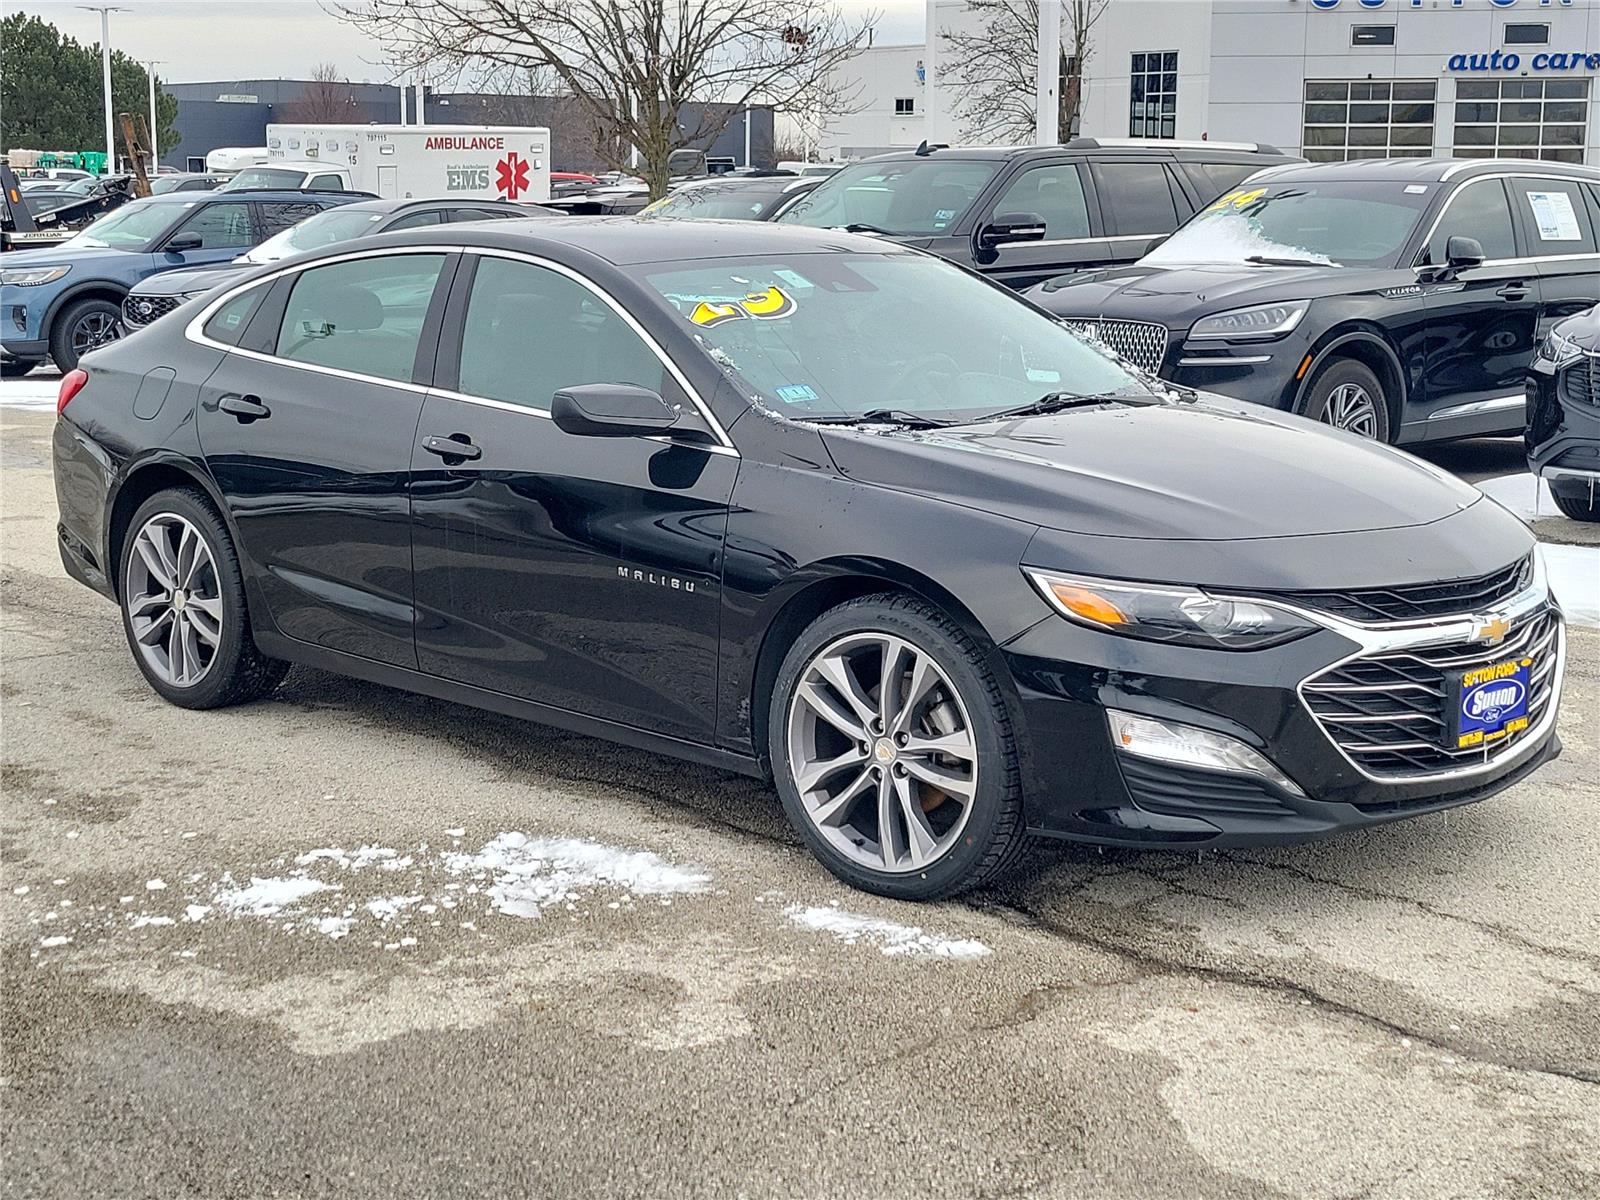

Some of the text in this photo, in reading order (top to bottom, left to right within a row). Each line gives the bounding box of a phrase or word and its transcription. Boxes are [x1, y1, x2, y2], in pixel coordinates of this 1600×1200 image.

[1449, 50, 1600, 71] auto care
[425, 137, 504, 150] AMBULANCE
[348, 155, 357, 165] 15
[447, 170, 489, 191] EMS
[1387, 286, 1421, 296] AVIATOR
[617, 566, 695, 593] MALIBU
[1463, 665, 1497, 688] SUTTON
[1472, 686, 1517, 715] Sutton
